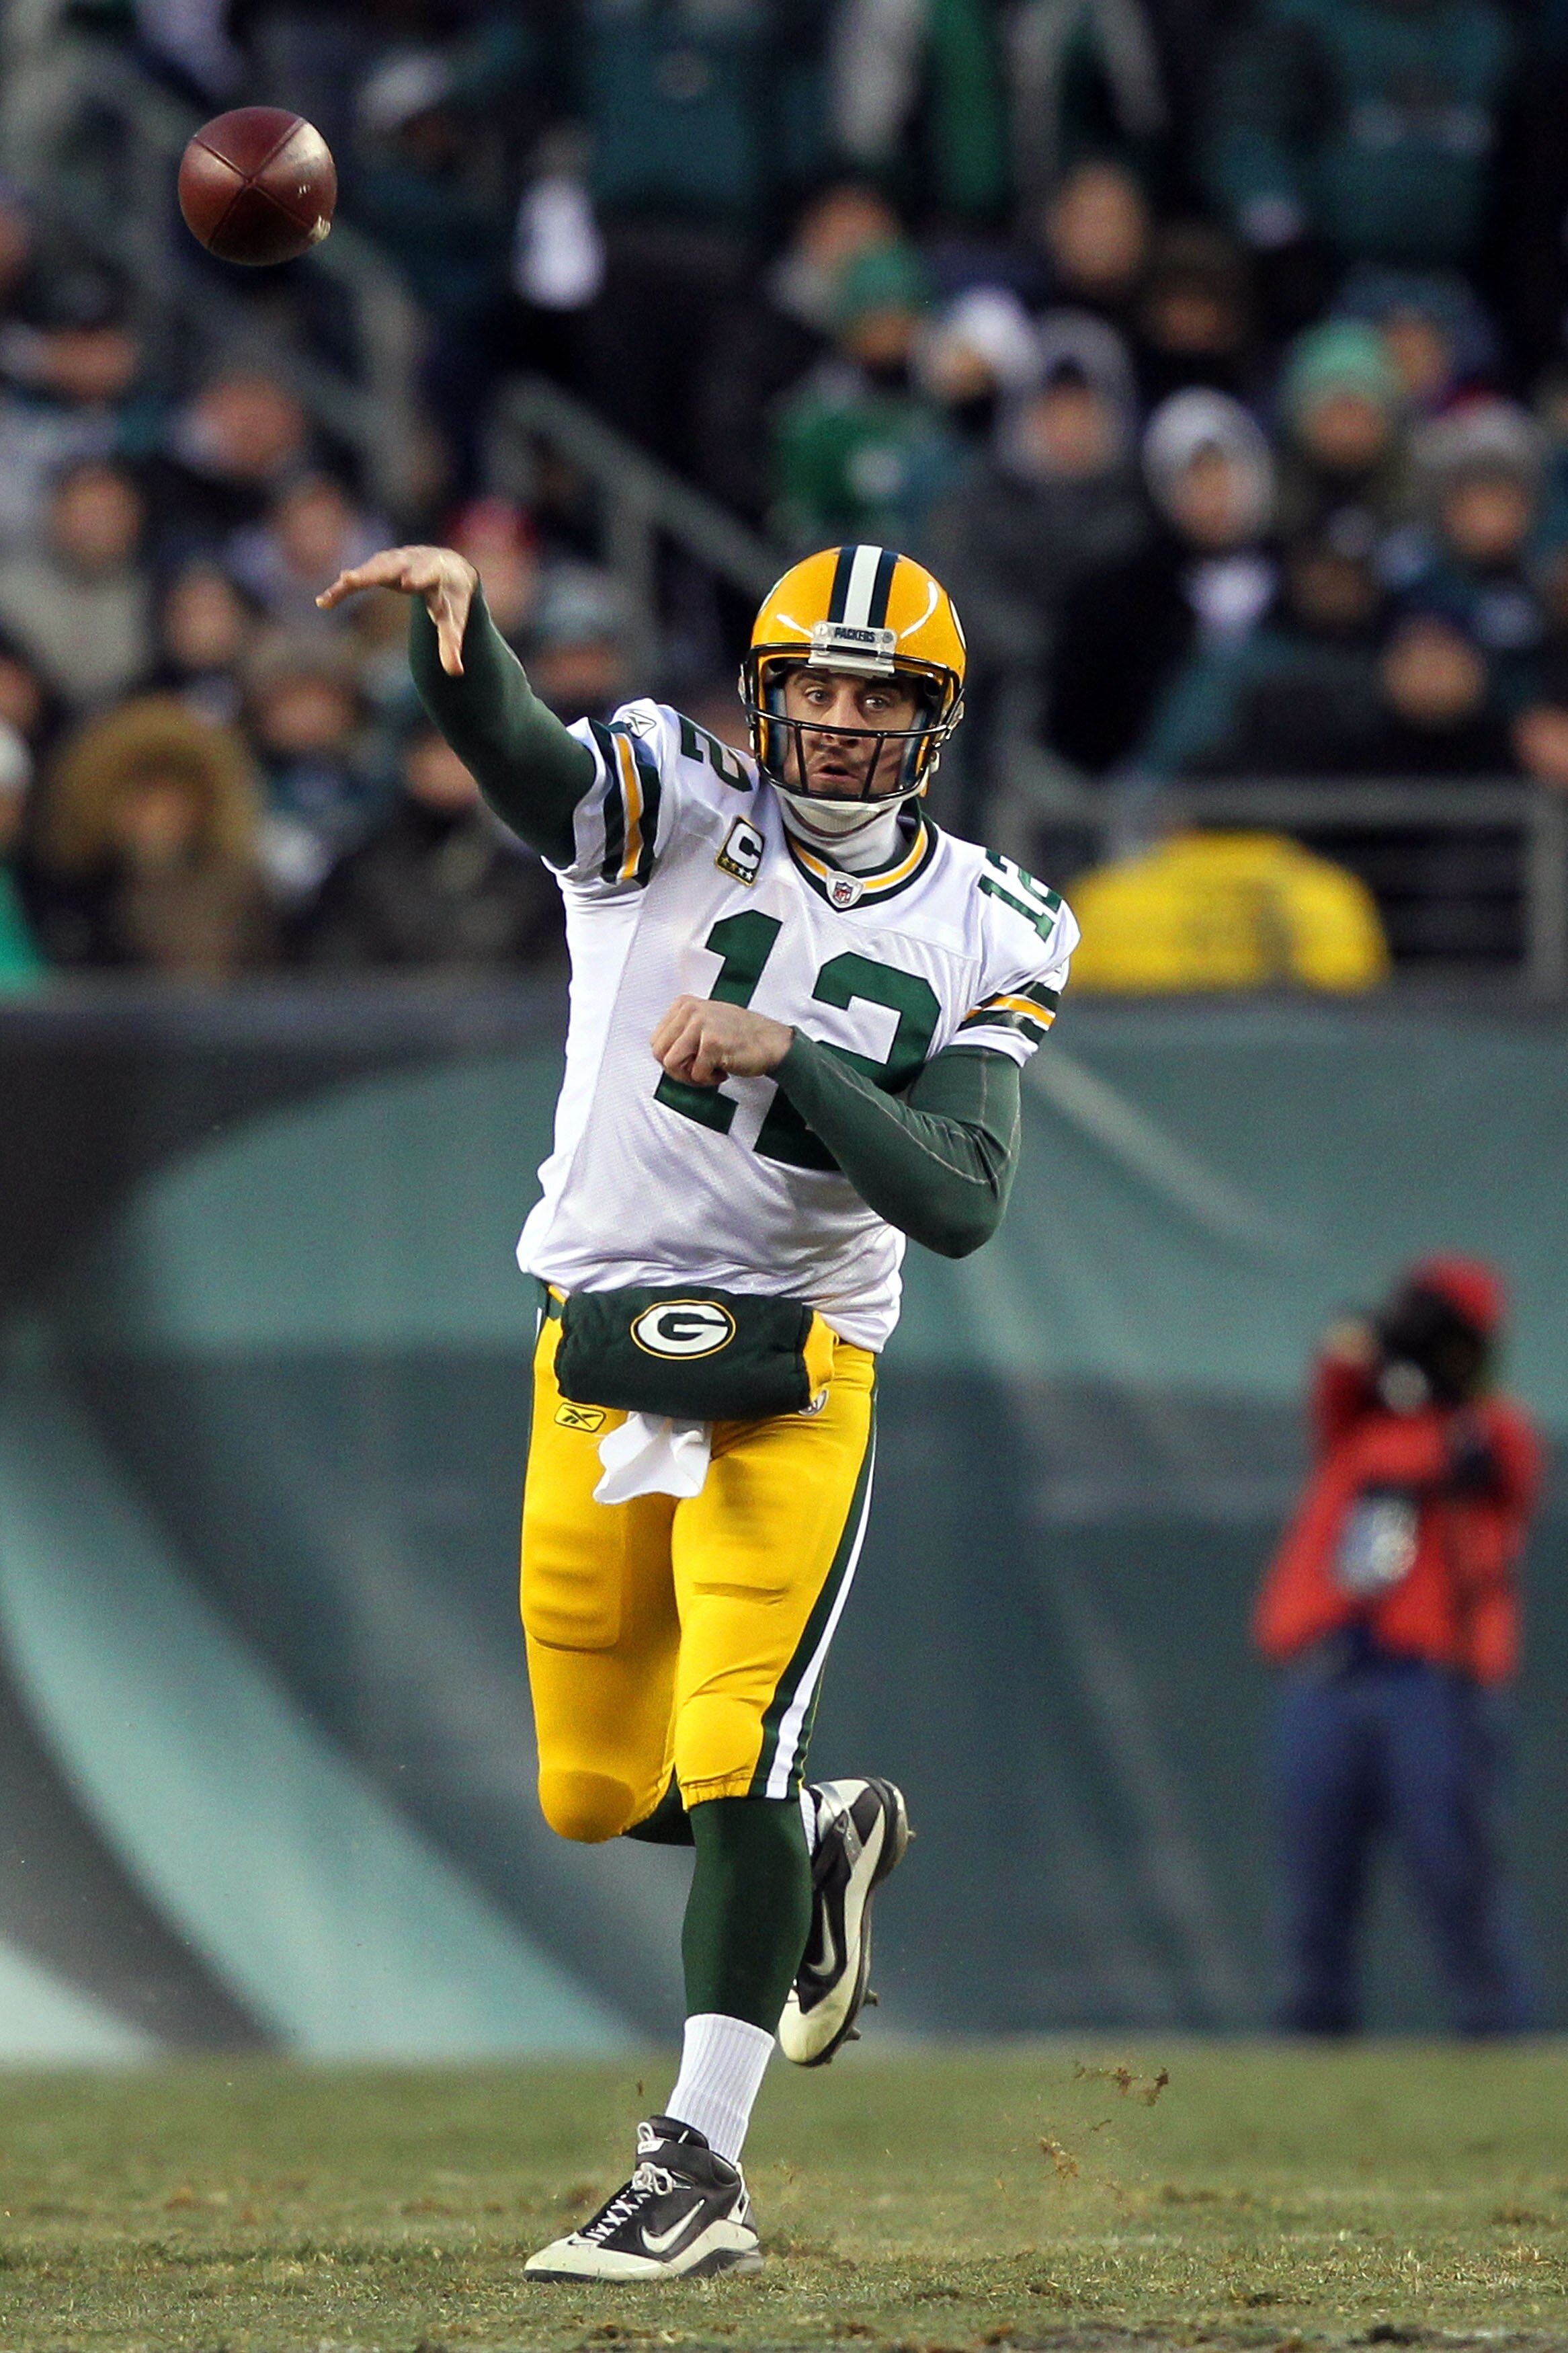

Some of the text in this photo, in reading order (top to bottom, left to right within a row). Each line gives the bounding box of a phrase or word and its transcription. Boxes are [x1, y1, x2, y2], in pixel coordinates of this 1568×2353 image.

[835, 627, 876, 643] PACKERS
[726, 822, 763, 869] C
[977, 848, 1063, 943] 12
[653, 909, 942, 1172] 12
[637, 1304, 729, 1354] G
